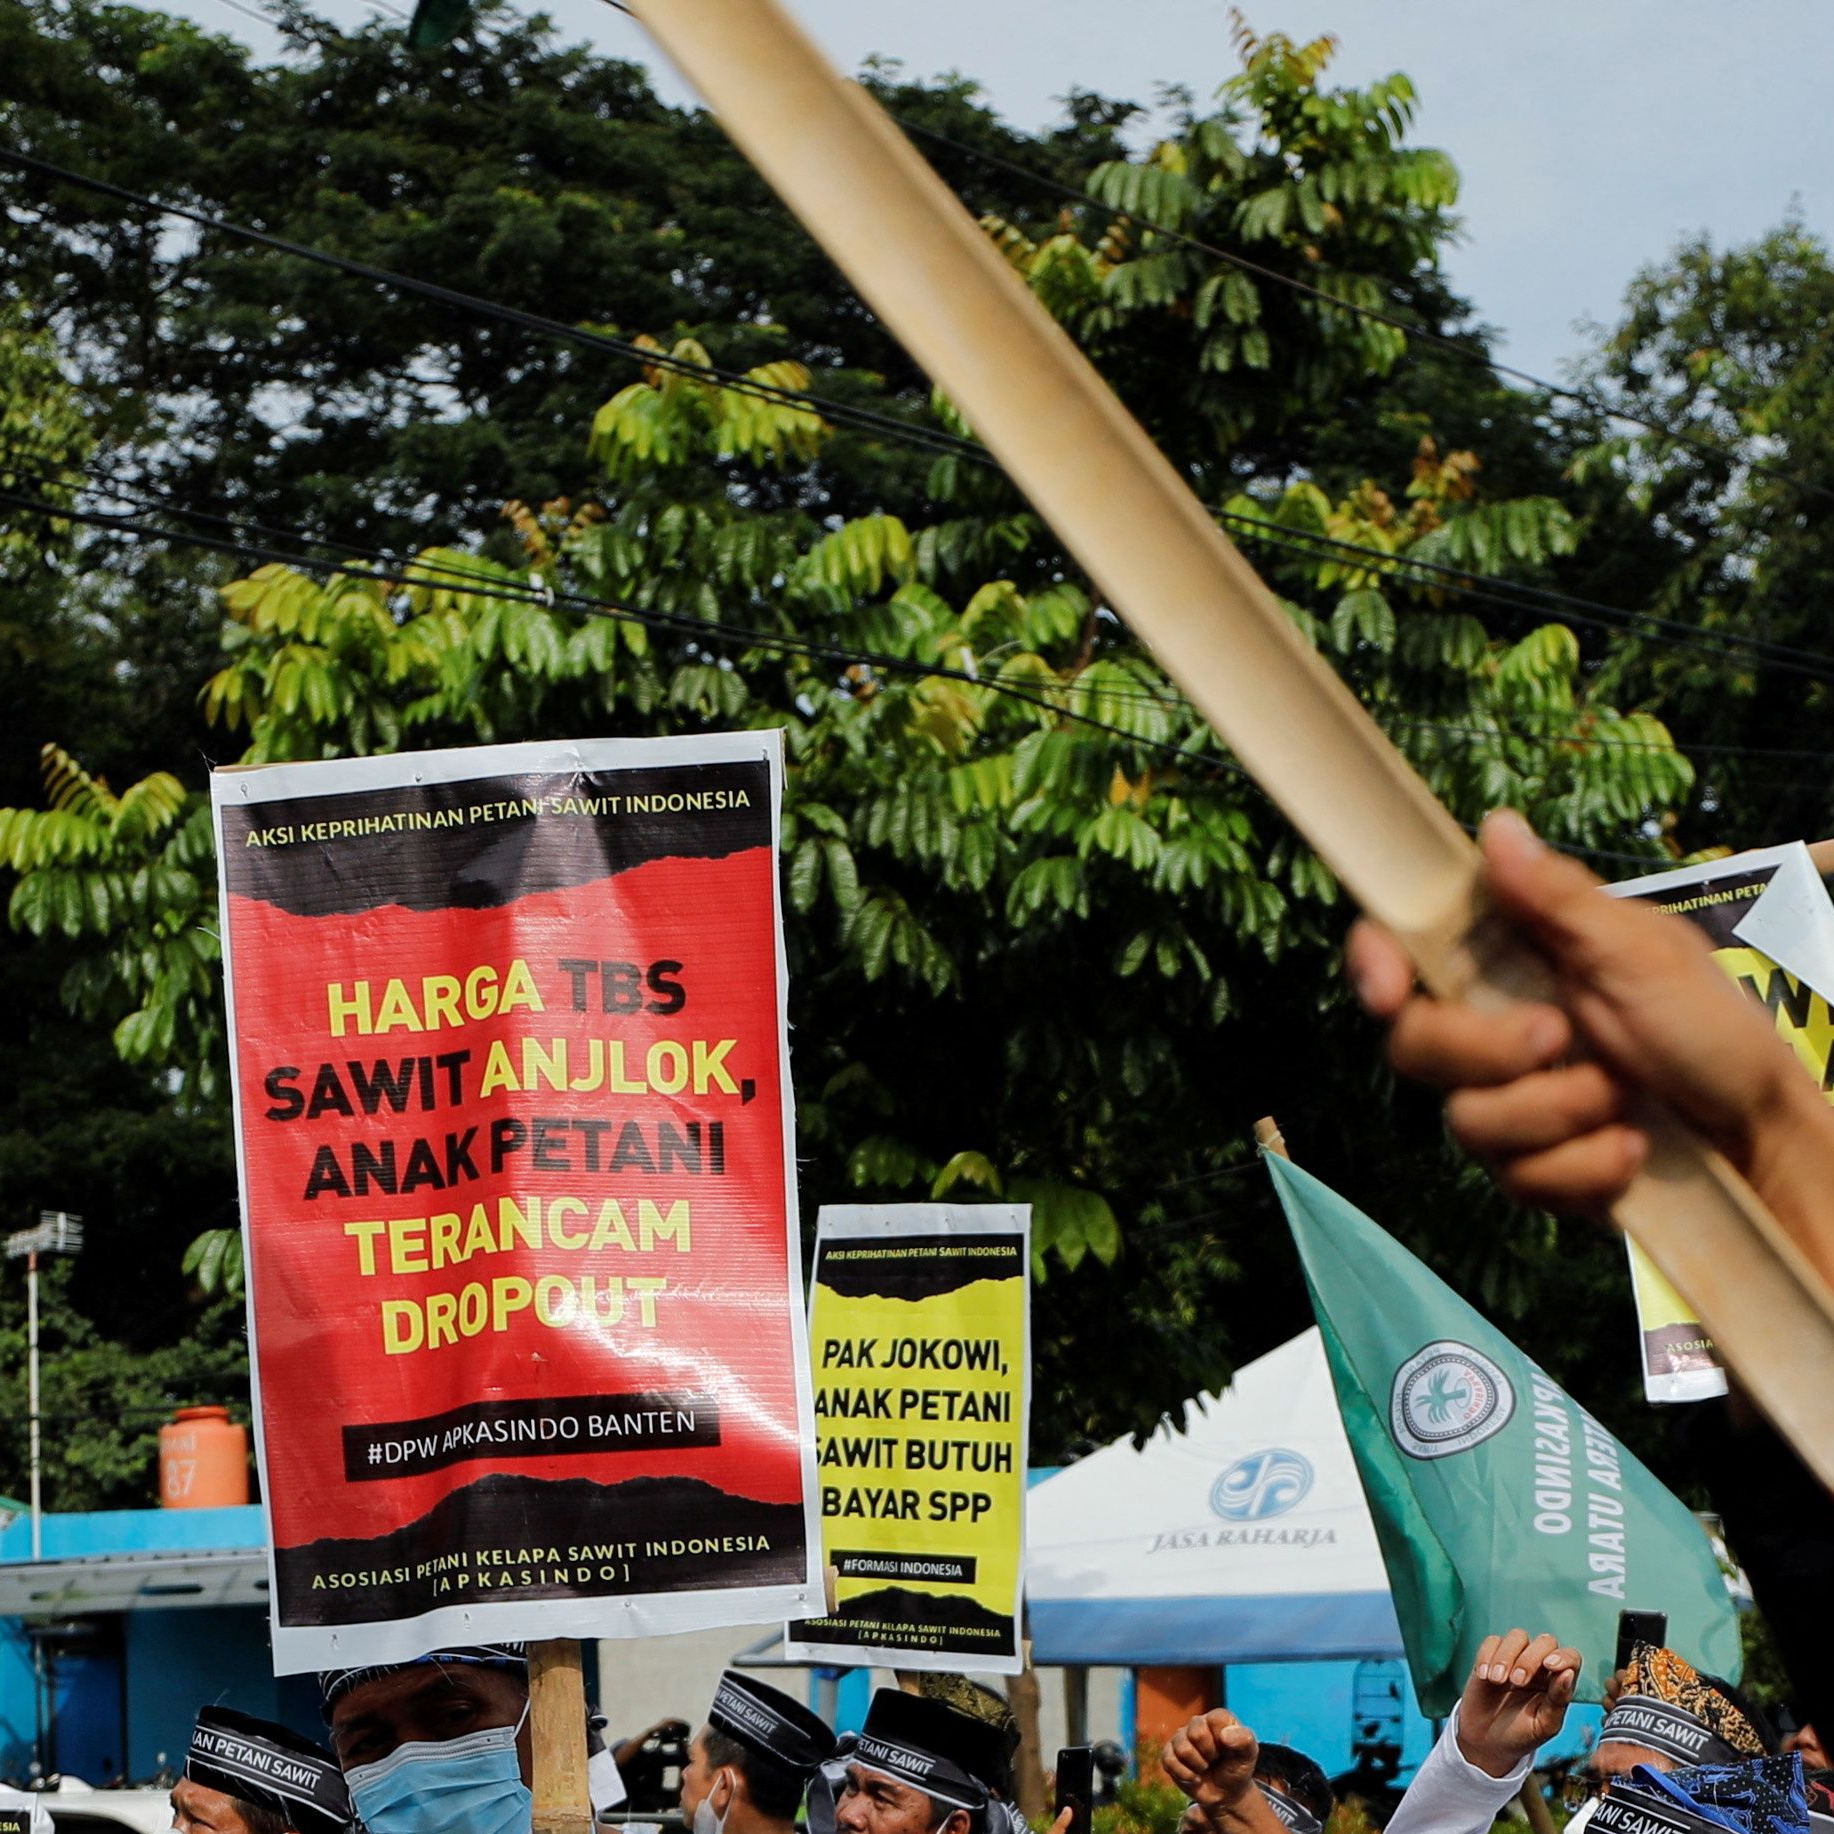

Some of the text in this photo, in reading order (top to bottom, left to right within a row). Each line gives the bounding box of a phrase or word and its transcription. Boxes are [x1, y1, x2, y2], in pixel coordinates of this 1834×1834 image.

[245, 789, 751, 848] AKSI KEPRIHATINAN PETANI SAWIT INDONESIA
[328, 958, 687, 1037] HARGA TBS
[263, 1037, 756, 1121] SAWIT ANJLOK,
[301, 1117, 726, 1201] ANAK PETANI
[344, 1195, 692, 1278] TERANCAM
[825, 1246, 1017, 1260] AKSI KEPRIHATINAN PETANI SAWIT INDONESIA
[381, 1275, 668, 1356] DROPOUT
[822, 1338, 1008, 1377] PAK JOKOWI,
[815, 1387, 1011, 1423] ANAK PETANI
[368, 1410, 696, 1464] #DPW APKASINDO BANTEN
[905, 1439, 1012, 1474] BUTUH
[822, 1486, 992, 1524] BAYAR SPP
[1146, 1528, 1338, 1555] JASA RAHARJA
[312, 1535, 771, 1590] ASOSIASI PETANI KELAPA SAWIT INDONESIA
[843, 1558, 963, 1577] #FORMASI INDONESIA
[849, 1619, 880, 1630] PETANI
[882, 1622, 916, 1633] KELAPA
[918, 1624, 947, 1634] SAWIT
[949, 1626, 1002, 1638] INDONESIA
[744, 1706, 778, 1735] SAWIT
[1653, 1718, 1710, 1751] SAWIT
[215, 1737, 271, 1772] PETANI
[271, 1759, 321, 1790] SAWIT
[889, 1749, 935, 1776] SAWIT
